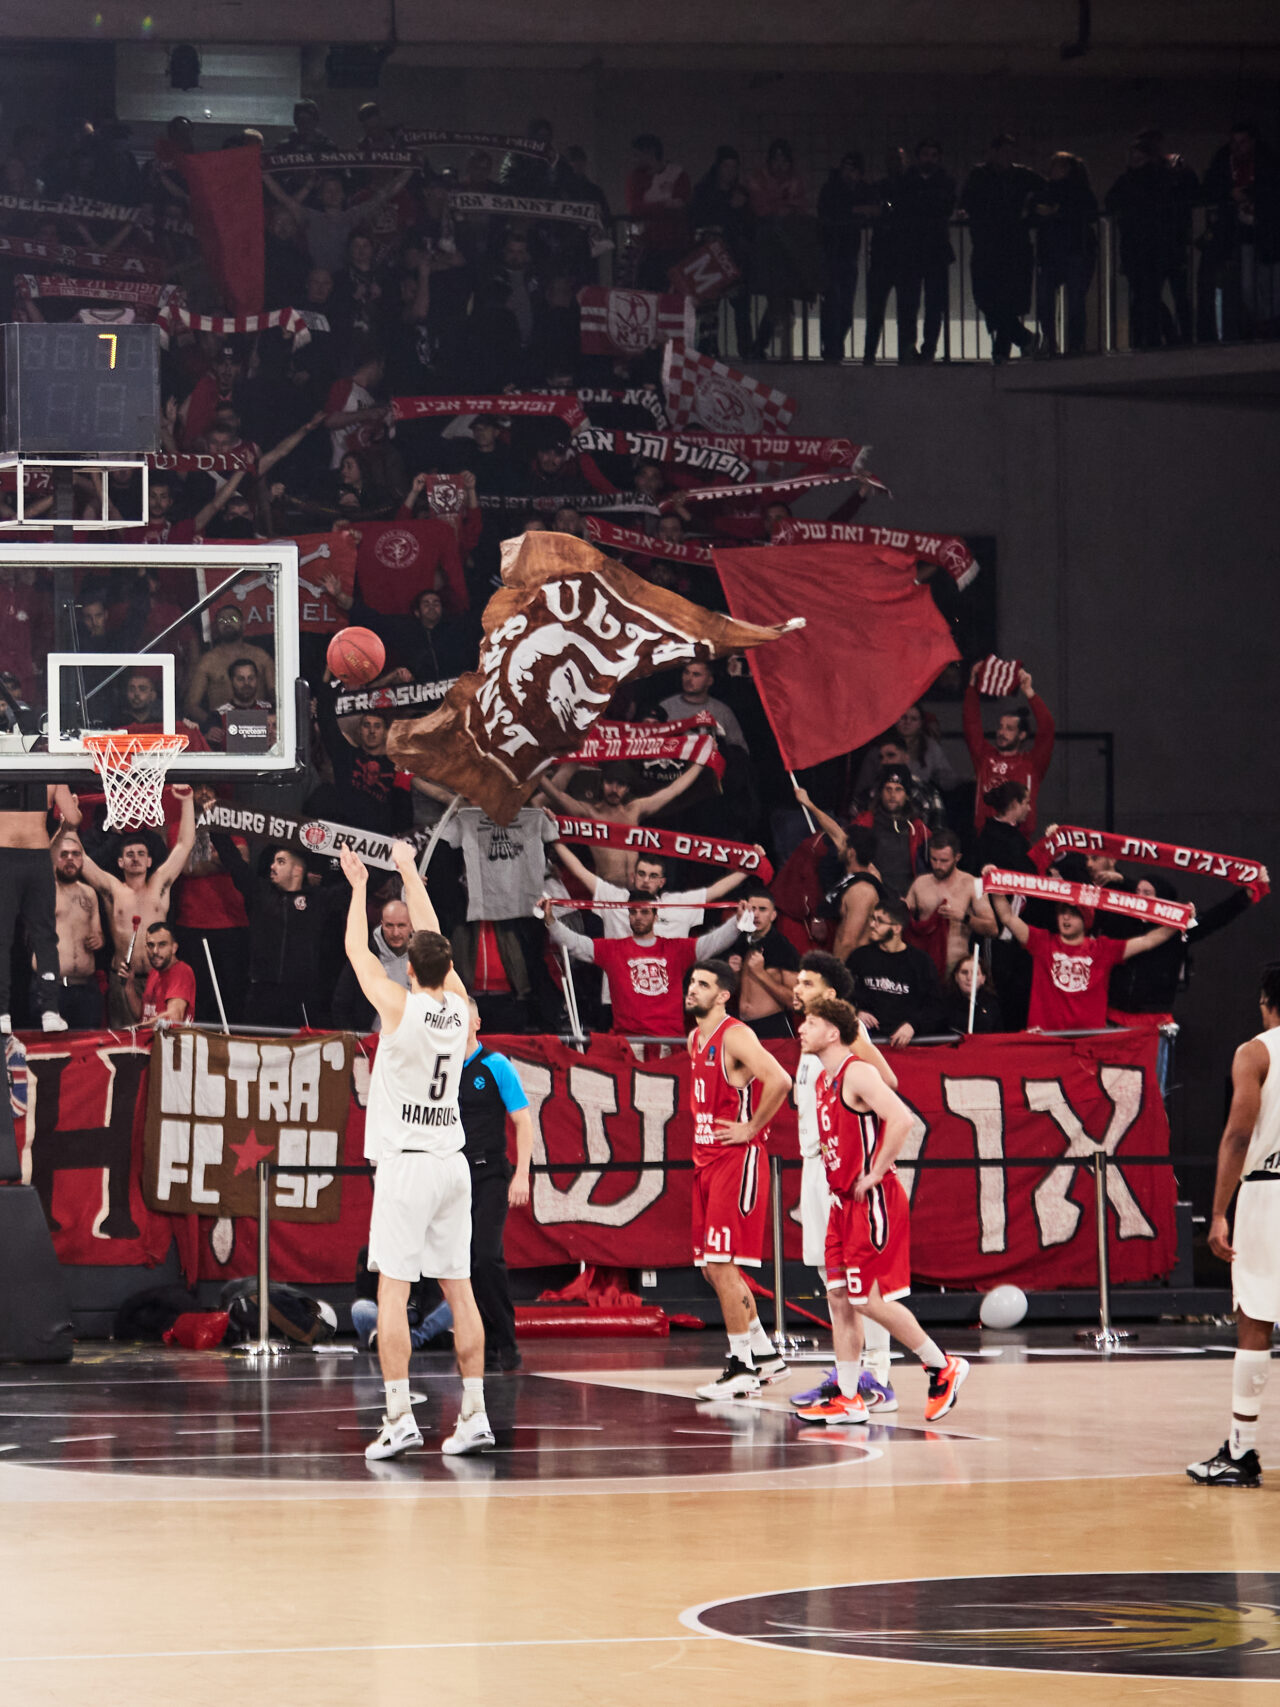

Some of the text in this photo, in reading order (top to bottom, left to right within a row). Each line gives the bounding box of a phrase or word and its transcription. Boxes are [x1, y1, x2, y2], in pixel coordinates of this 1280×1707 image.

[97, 333, 118, 370] 7
[832, 525, 864, 541] ואת
[870, 527, 910, 549] שלך
[914, 532, 942, 556] אני
[331, 832, 392, 862] BRAUN
[625, 825, 662, 847] את
[1120, 837, 1161, 858] את
[990, 871, 1185, 923] HAMBURG SIND WIR
[428, 1053, 452, 1101] 5
[820, 1104, 832, 1131] 6
[156, 1120, 224, 1205] FC
[707, 1225, 732, 1253] 41
[846, 1267, 861, 1294] 6
